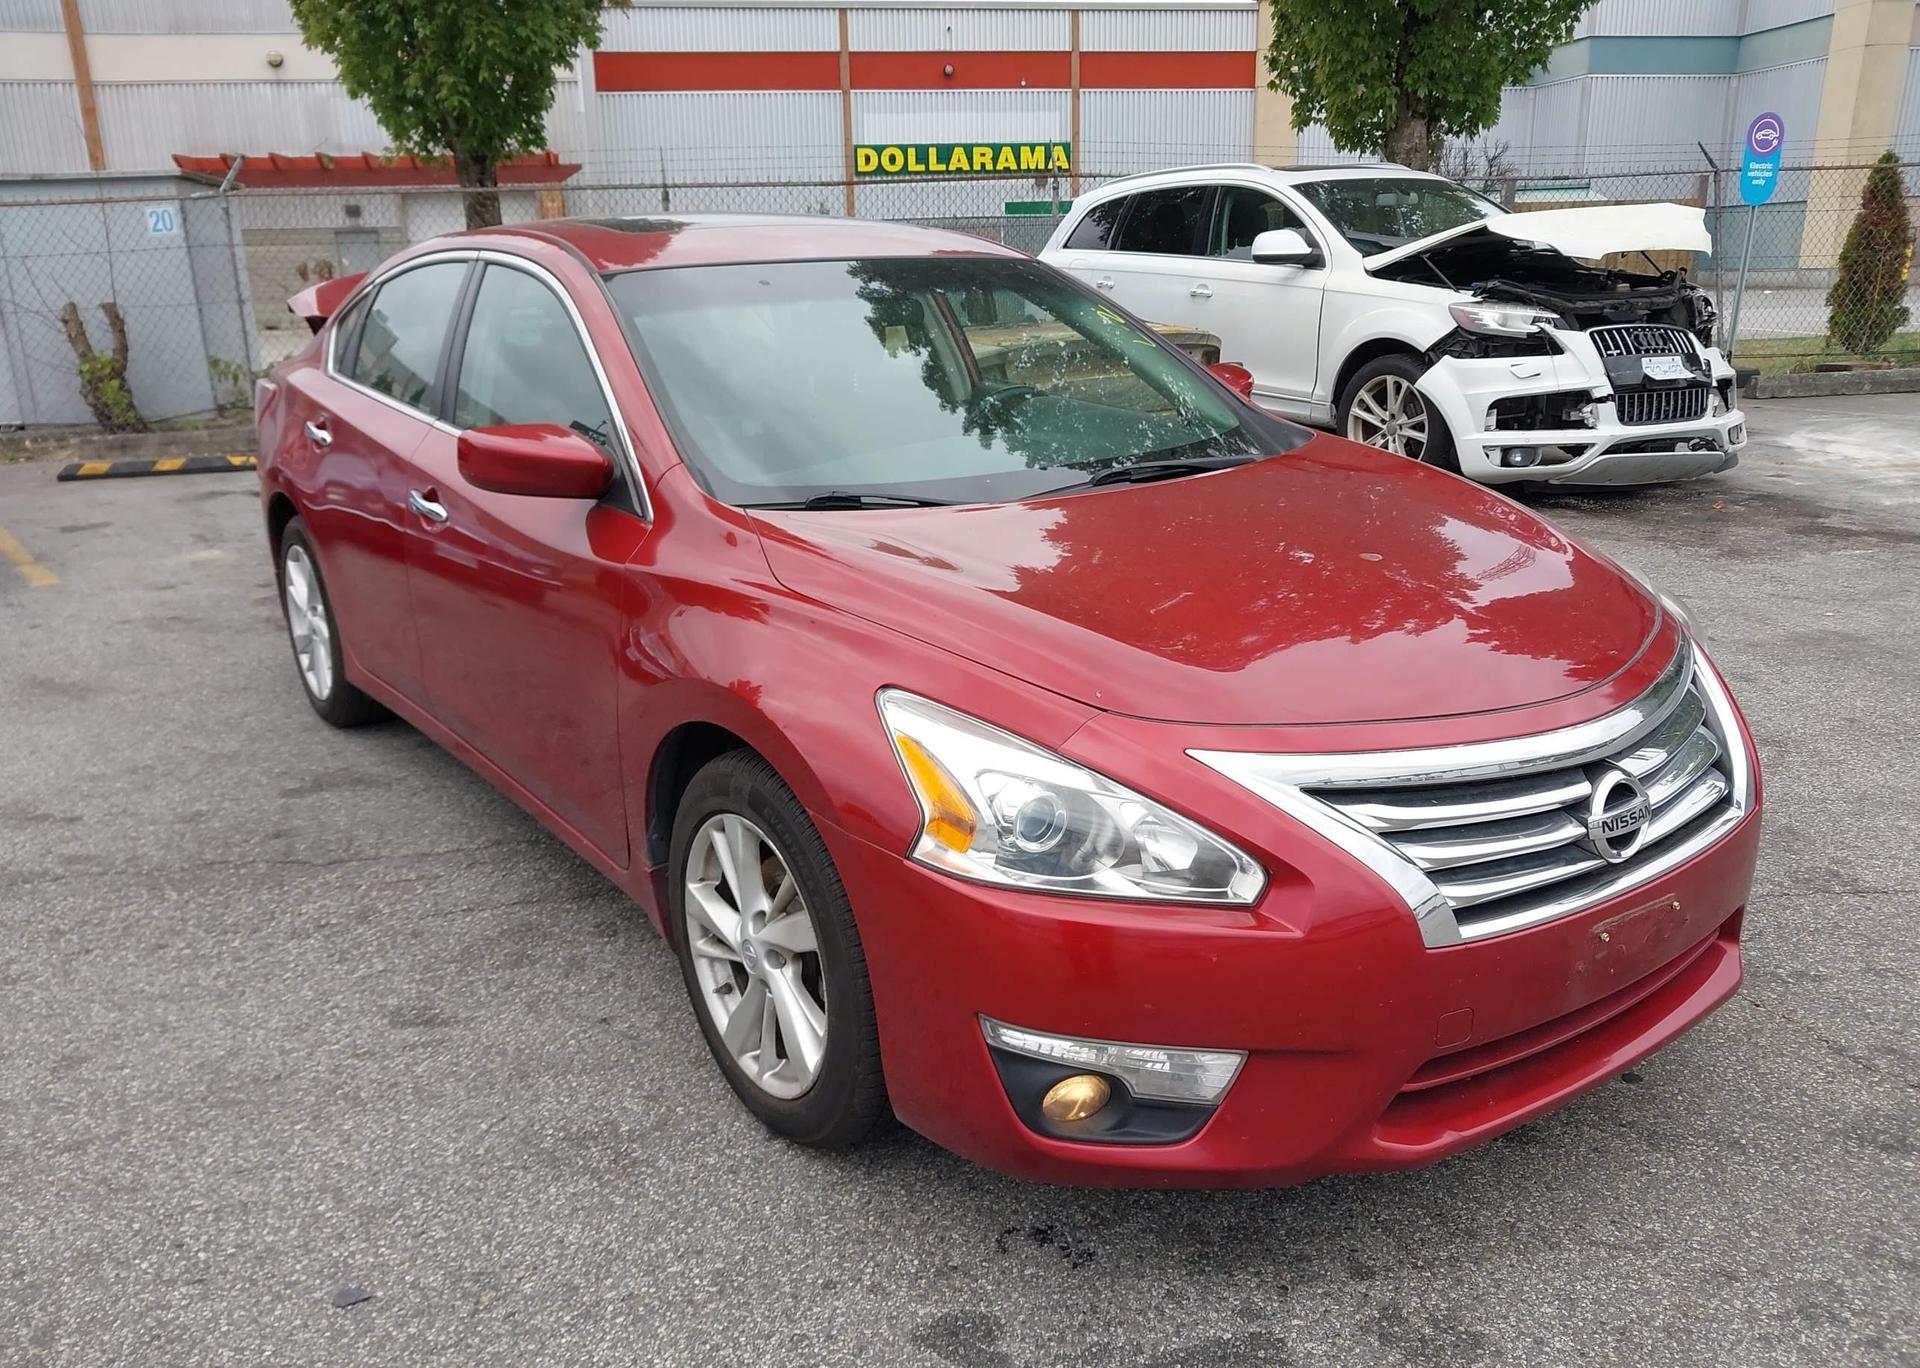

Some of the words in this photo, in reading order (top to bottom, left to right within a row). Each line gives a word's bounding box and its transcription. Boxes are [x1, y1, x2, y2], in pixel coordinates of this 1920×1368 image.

[856, 145, 1070, 173] DOLLARAMA
[1749, 161, 1774, 169] Electric
[1751, 178, 1766, 187] only
[149, 209, 174, 233] 20
[1601, 804, 1651, 834] NISSAN
